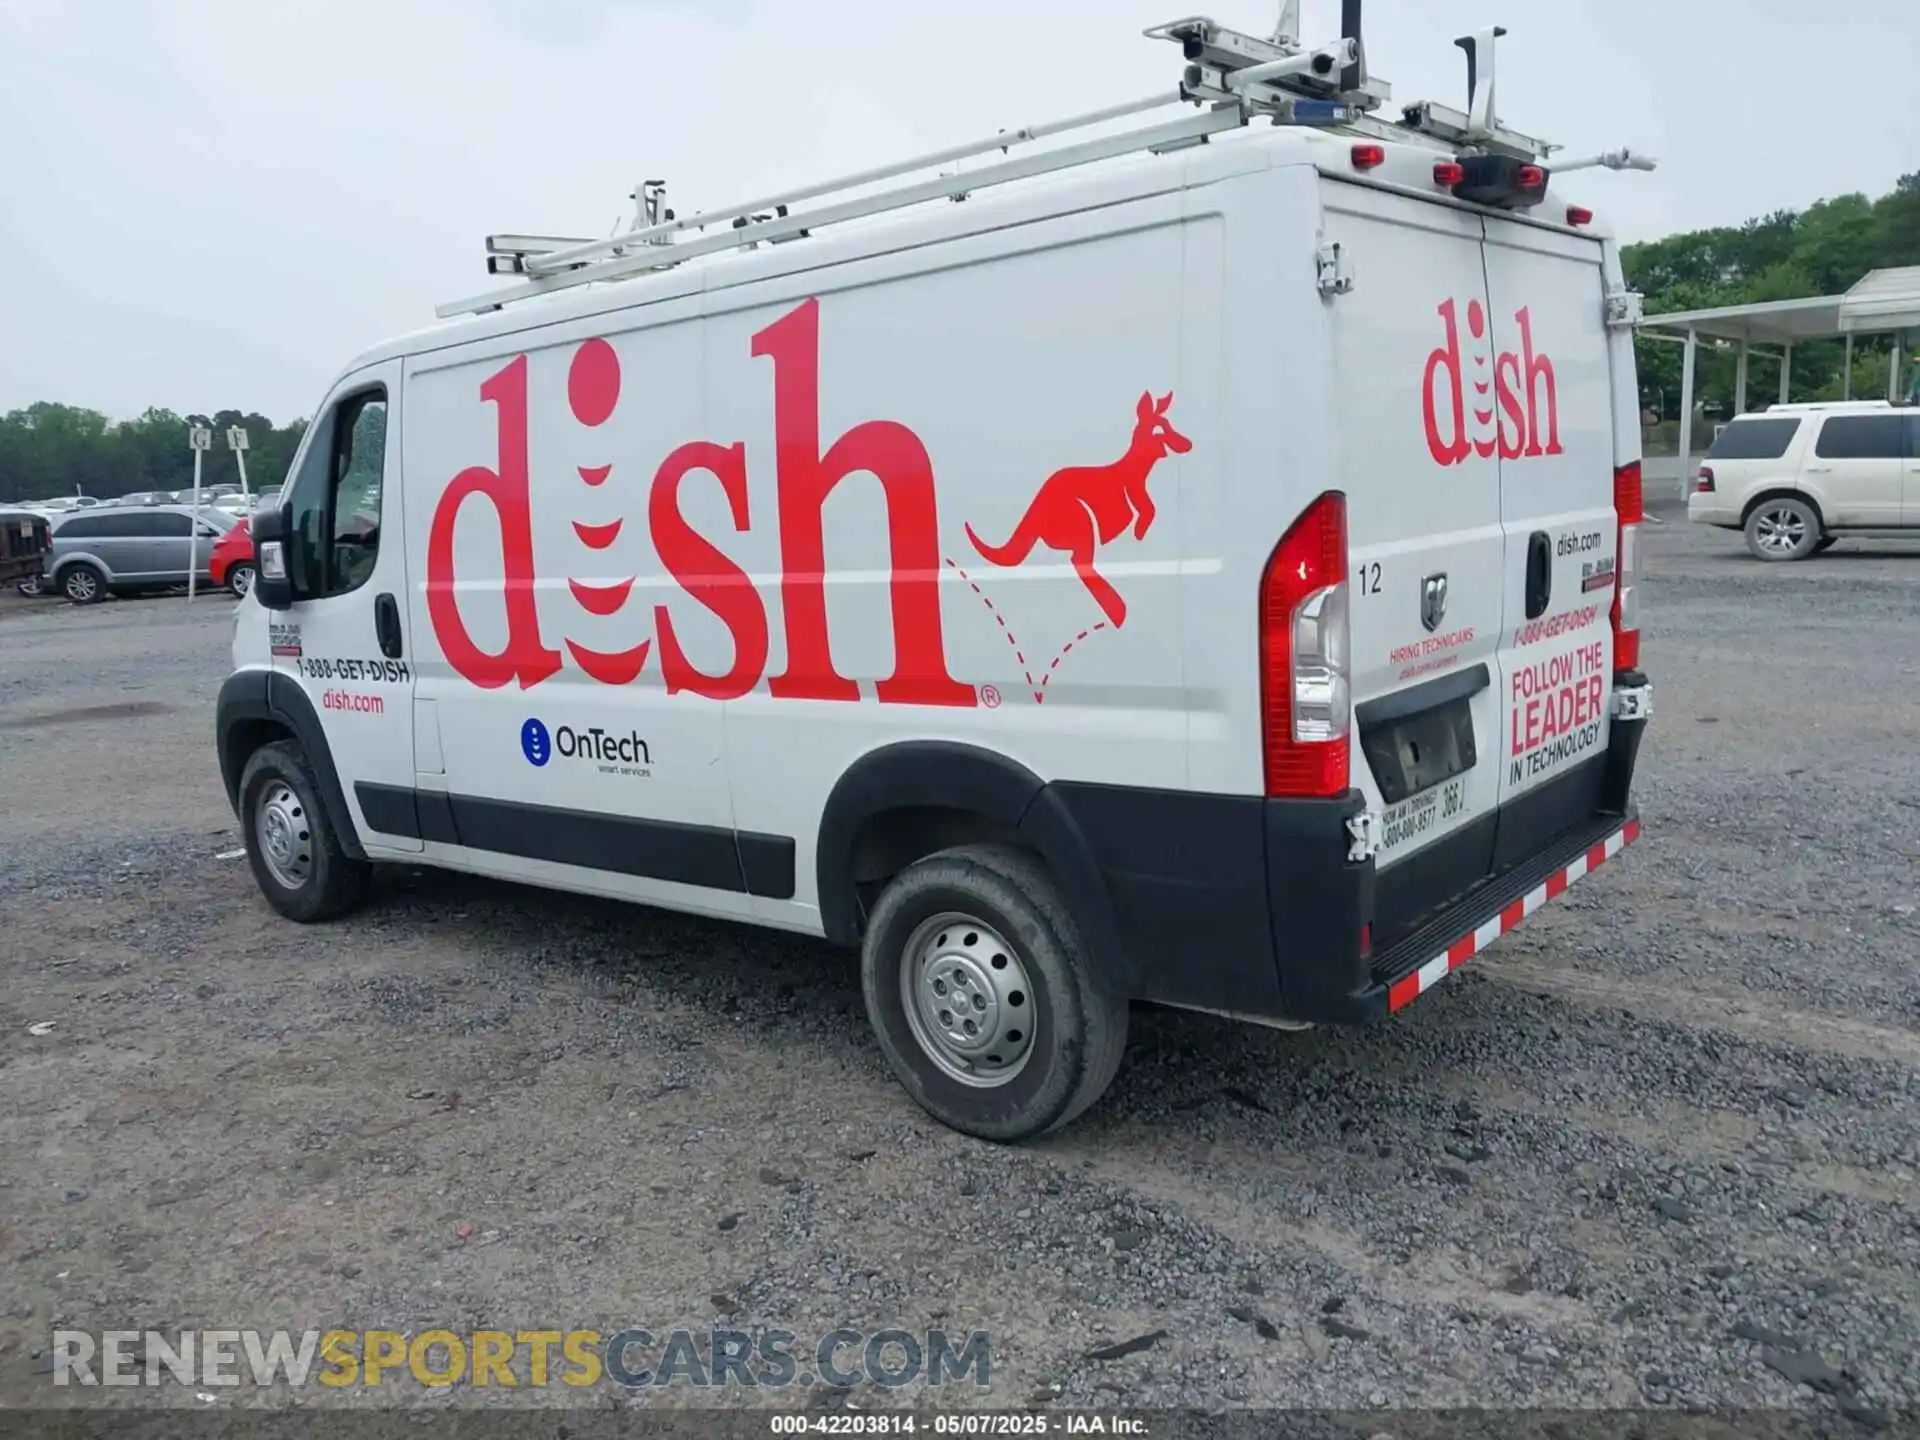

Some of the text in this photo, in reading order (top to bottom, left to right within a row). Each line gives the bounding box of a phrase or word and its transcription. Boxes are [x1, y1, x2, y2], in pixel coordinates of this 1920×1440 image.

[1423, 296, 1565, 467] dish
[426, 296, 978, 708] dish
[1557, 531, 1602, 556] dish.com
[1359, 562, 1382, 596] 12
[296, 658, 410, 682] 1-888-GET-DISH
[1390, 642, 1420, 664] HIRING
[1512, 642, 1603, 702] FOLLOW THE
[323, 688, 384, 713] dish.com
[1511, 674, 1604, 756] LEADER
[556, 726, 649, 764] OnTech
[1510, 721, 1601, 785] IN TECHNOLOGY
[621, 767, 651, 777] services
